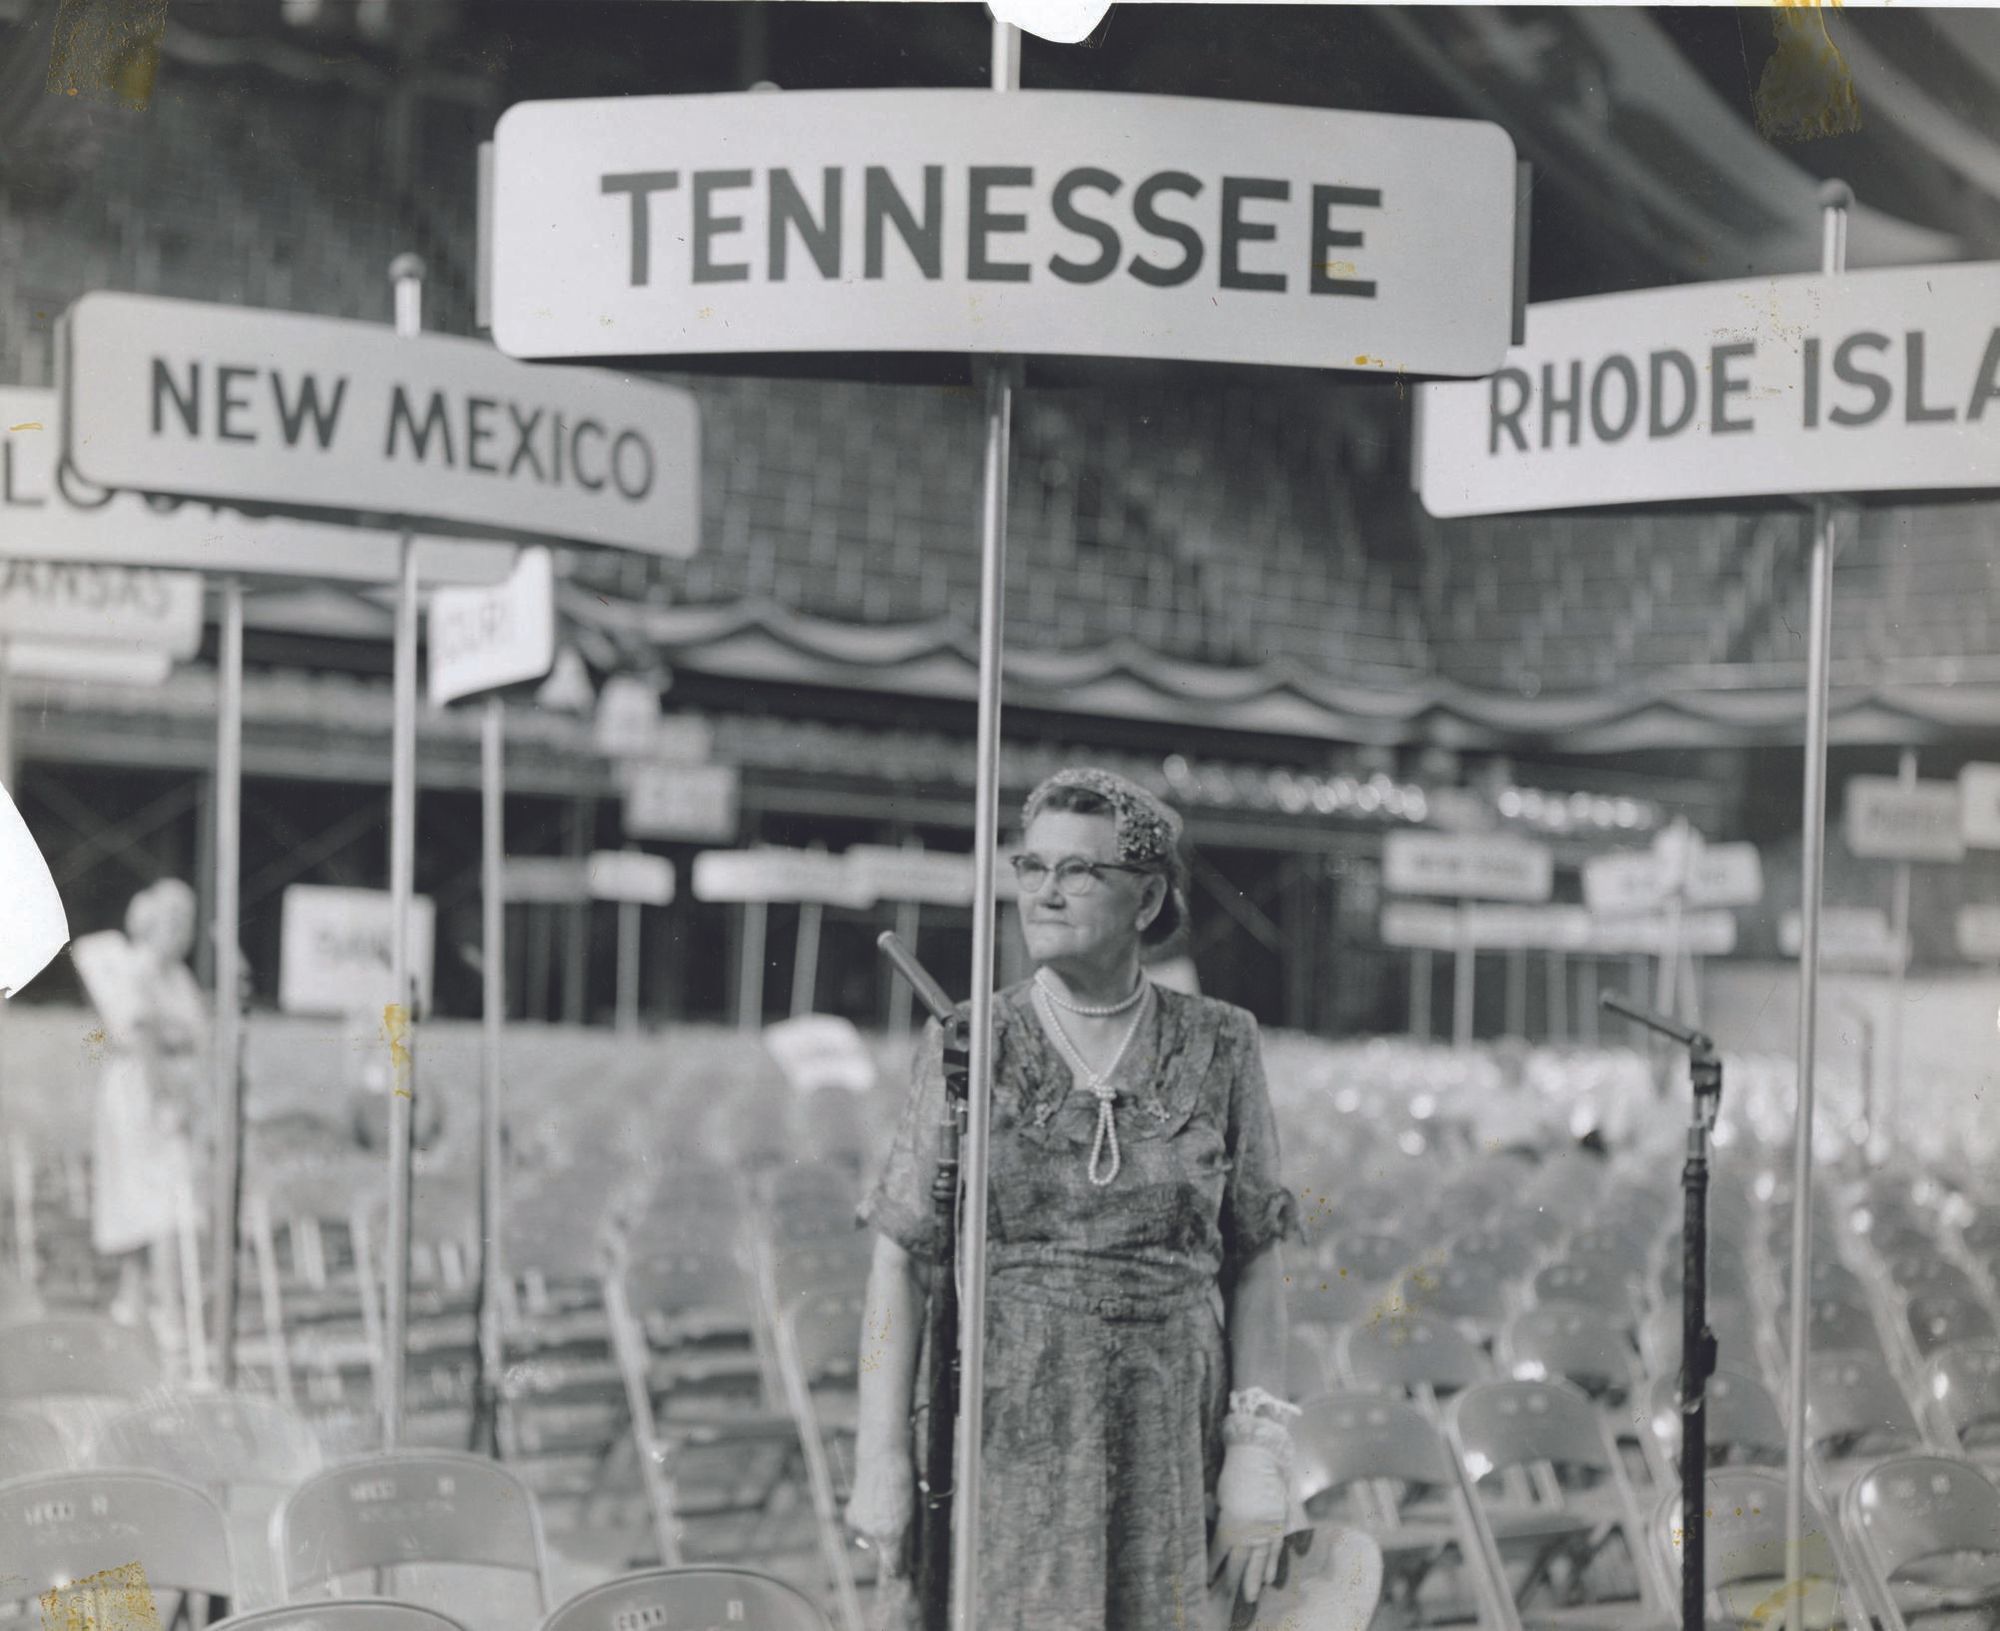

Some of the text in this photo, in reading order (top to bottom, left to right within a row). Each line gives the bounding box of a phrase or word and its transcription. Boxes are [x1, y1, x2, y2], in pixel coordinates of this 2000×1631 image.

[600, 163, 1385, 301] TENNESSEE
[150, 355, 349, 453] NEW
[382, 383, 656, 505] MEXICO
[1487, 325, 2000, 455] RHODE ISLA
